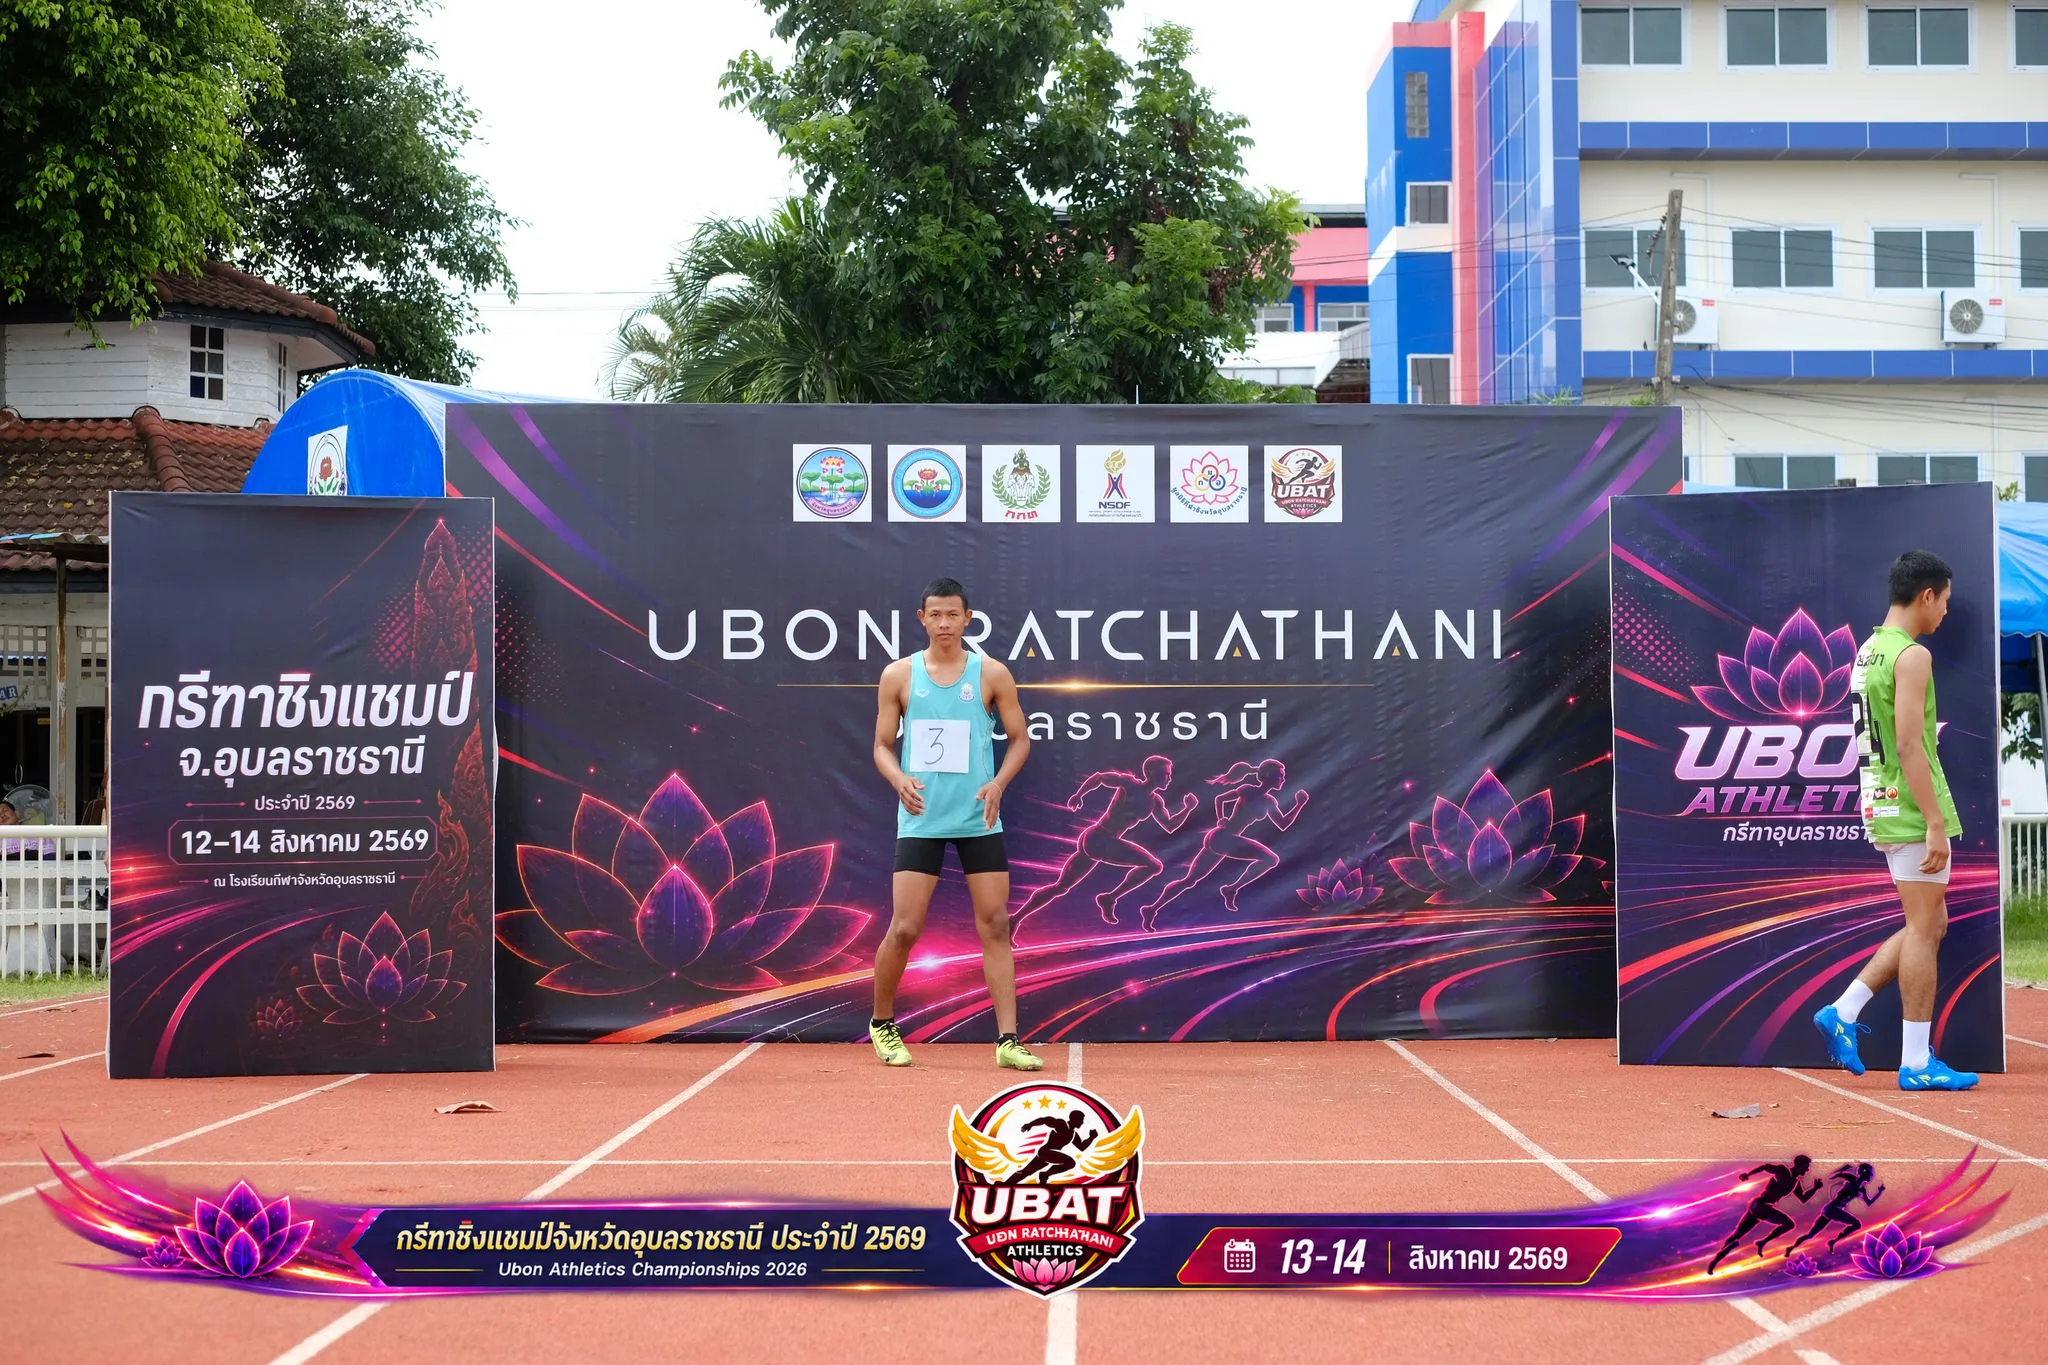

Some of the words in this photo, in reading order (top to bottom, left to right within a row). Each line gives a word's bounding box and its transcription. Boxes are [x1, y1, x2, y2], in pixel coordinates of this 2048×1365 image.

[1276, 484, 1330, 498] UBAT
[1098, 501, 1131, 509] NSDF
[648, 608, 901, 662] UBON
[138, 670, 474, 729] กรีฑาชิงแชมป์
[923, 727, 945, 765] 3
[179, 734, 426, 788] จ.อุบลราชธานี
[254, 794, 311, 811] ประจำปี
[315, 795, 356, 810] 2569
[270, 829, 360, 854] สิงหาคม
[369, 829, 429, 852] 2569
[214, 878, 226, 887] ณ
[229, 871, 397, 888] โรงเรียนกีฬาจังหวัดอุบลราชธานี
